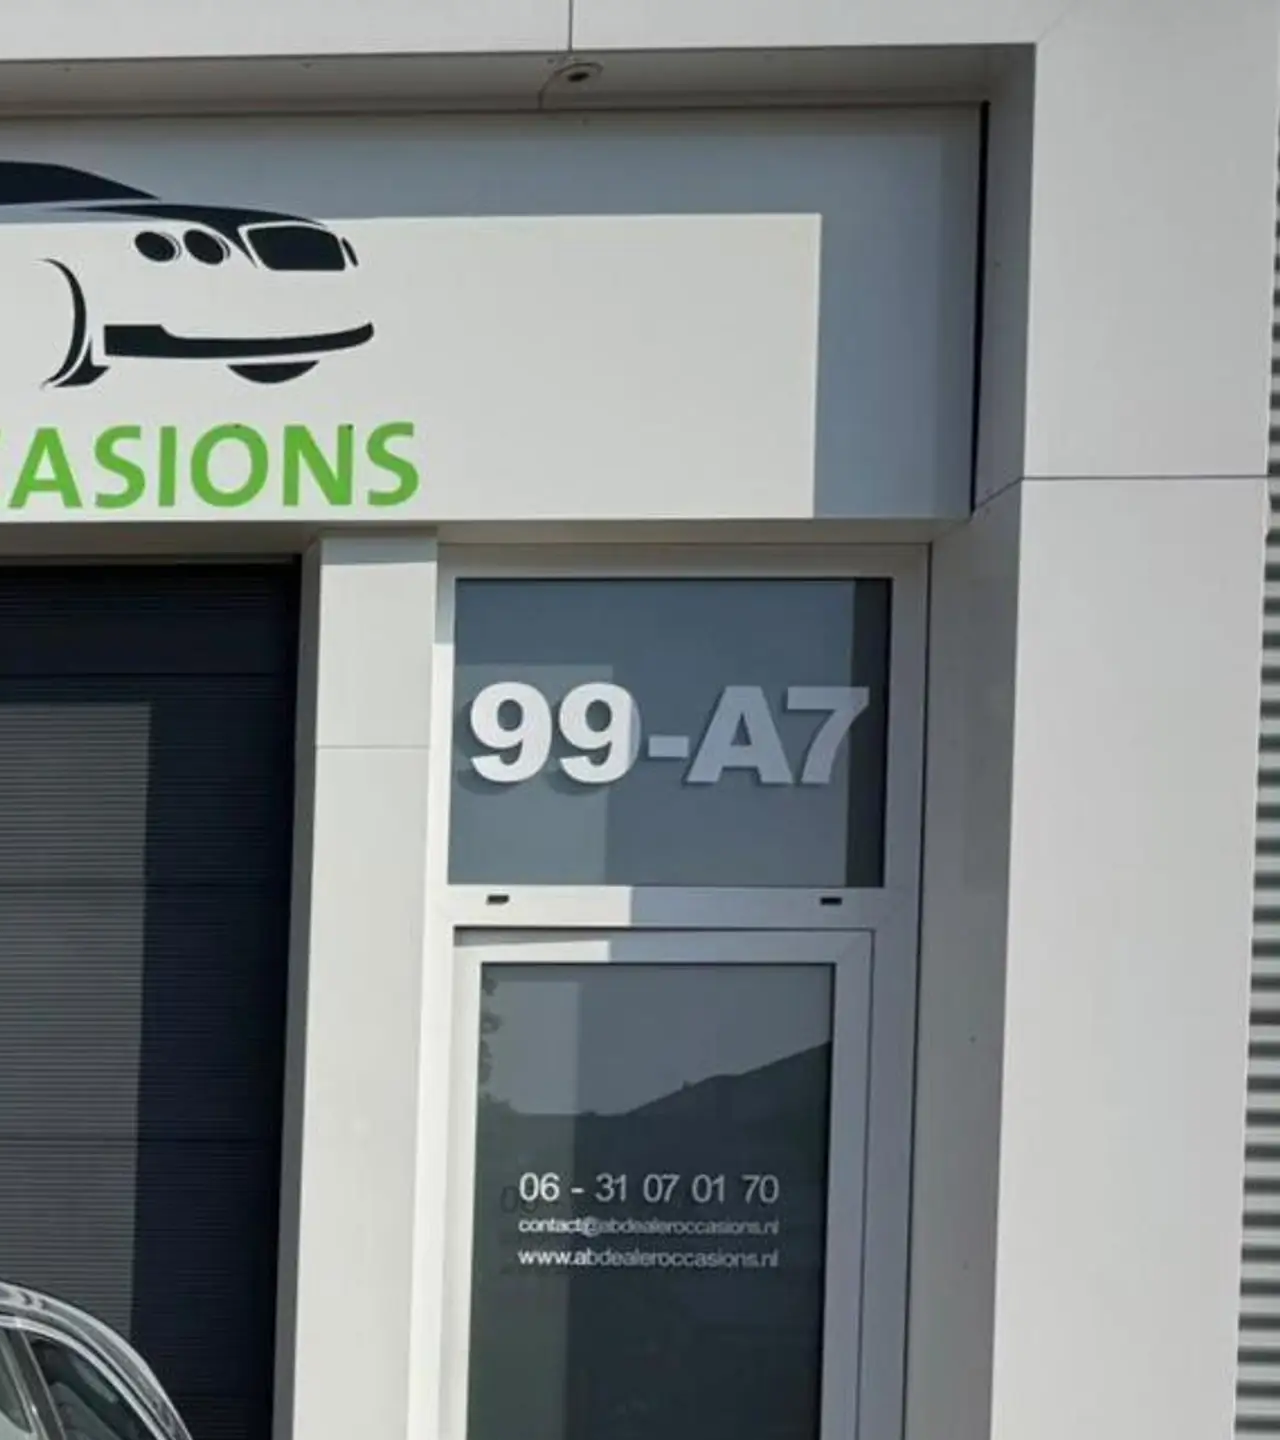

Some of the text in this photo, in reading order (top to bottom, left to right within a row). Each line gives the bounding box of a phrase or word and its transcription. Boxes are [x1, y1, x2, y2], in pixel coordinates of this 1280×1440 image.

[470, 681, 870, 783] 99-A7
[518, 1172, 560, 1202] 06
[595, 1173, 627, 1202] 31
[643, 1174, 680, 1202] 07
[692, 1174, 725, 1202] 01
[744, 1175, 779, 1202] 70
[517, 1247, 778, 1268] www.abdealeroccasions.nl
